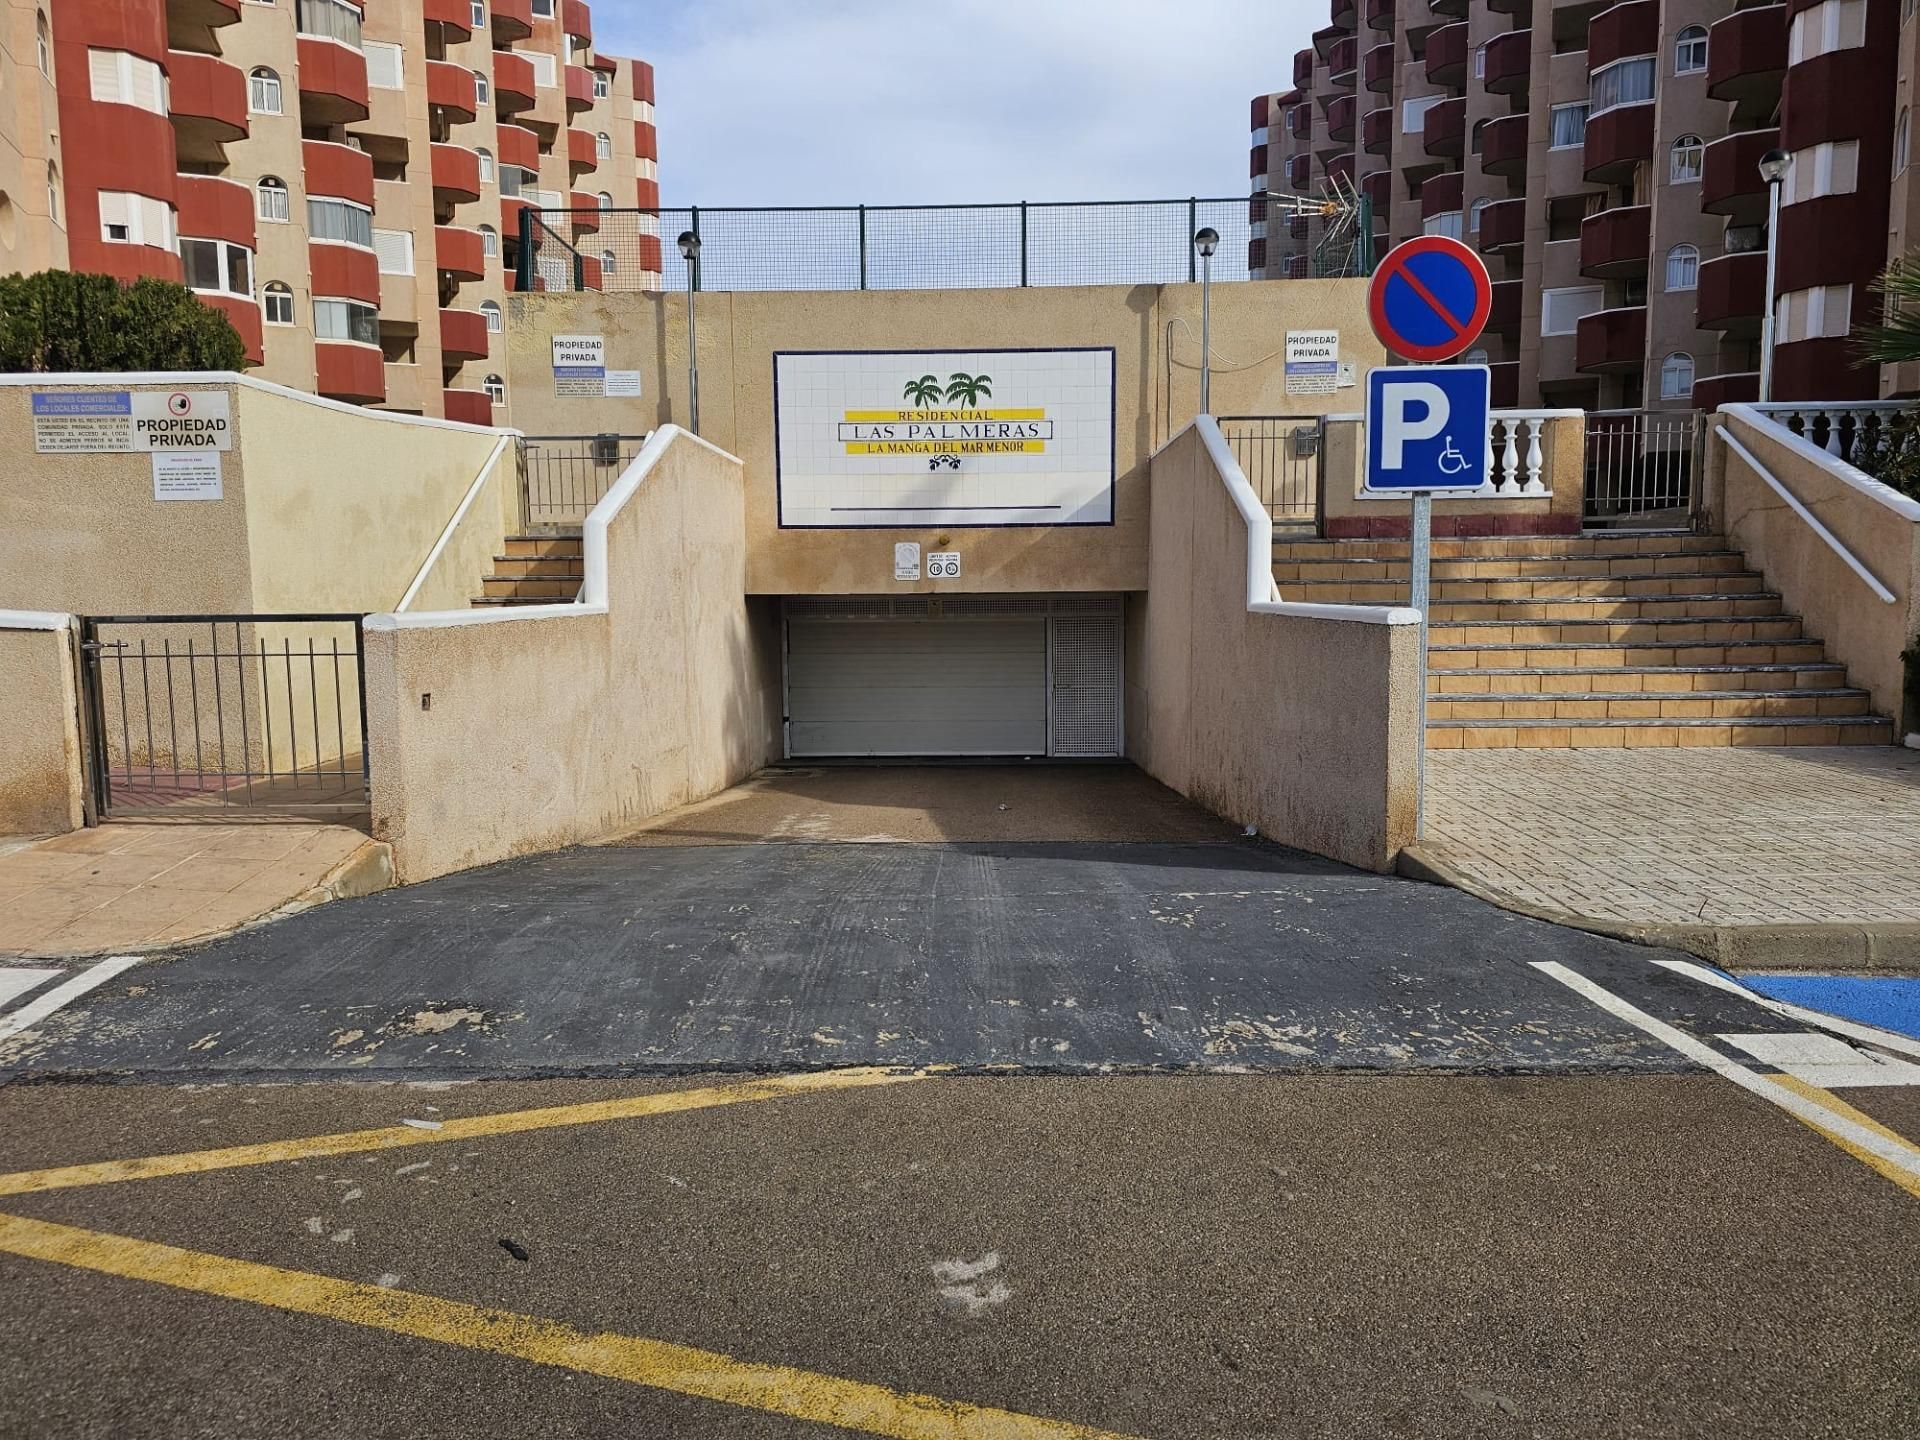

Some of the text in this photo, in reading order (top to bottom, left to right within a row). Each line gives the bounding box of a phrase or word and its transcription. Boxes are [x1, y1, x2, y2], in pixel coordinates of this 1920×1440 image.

[554, 341, 602, 349] PROPIEDAD
[1288, 336, 1336, 345] PROPIEDAD
[560, 353, 597, 361] PRIVADA
[1294, 349, 1330, 357] PRIVADA
[109, 395, 117, 403] DE
[898, 410, 993, 420] RESIDENCIAL
[137, 419, 226, 431] PROPIEDAD
[1381, 382, 1450, 470] P
[855, 423, 1039, 439] LAS PALMERAS
[149, 434, 216, 446] PRIVADA
[868, 441, 1024, 453] LA MANGA DEL MAR MENOR
